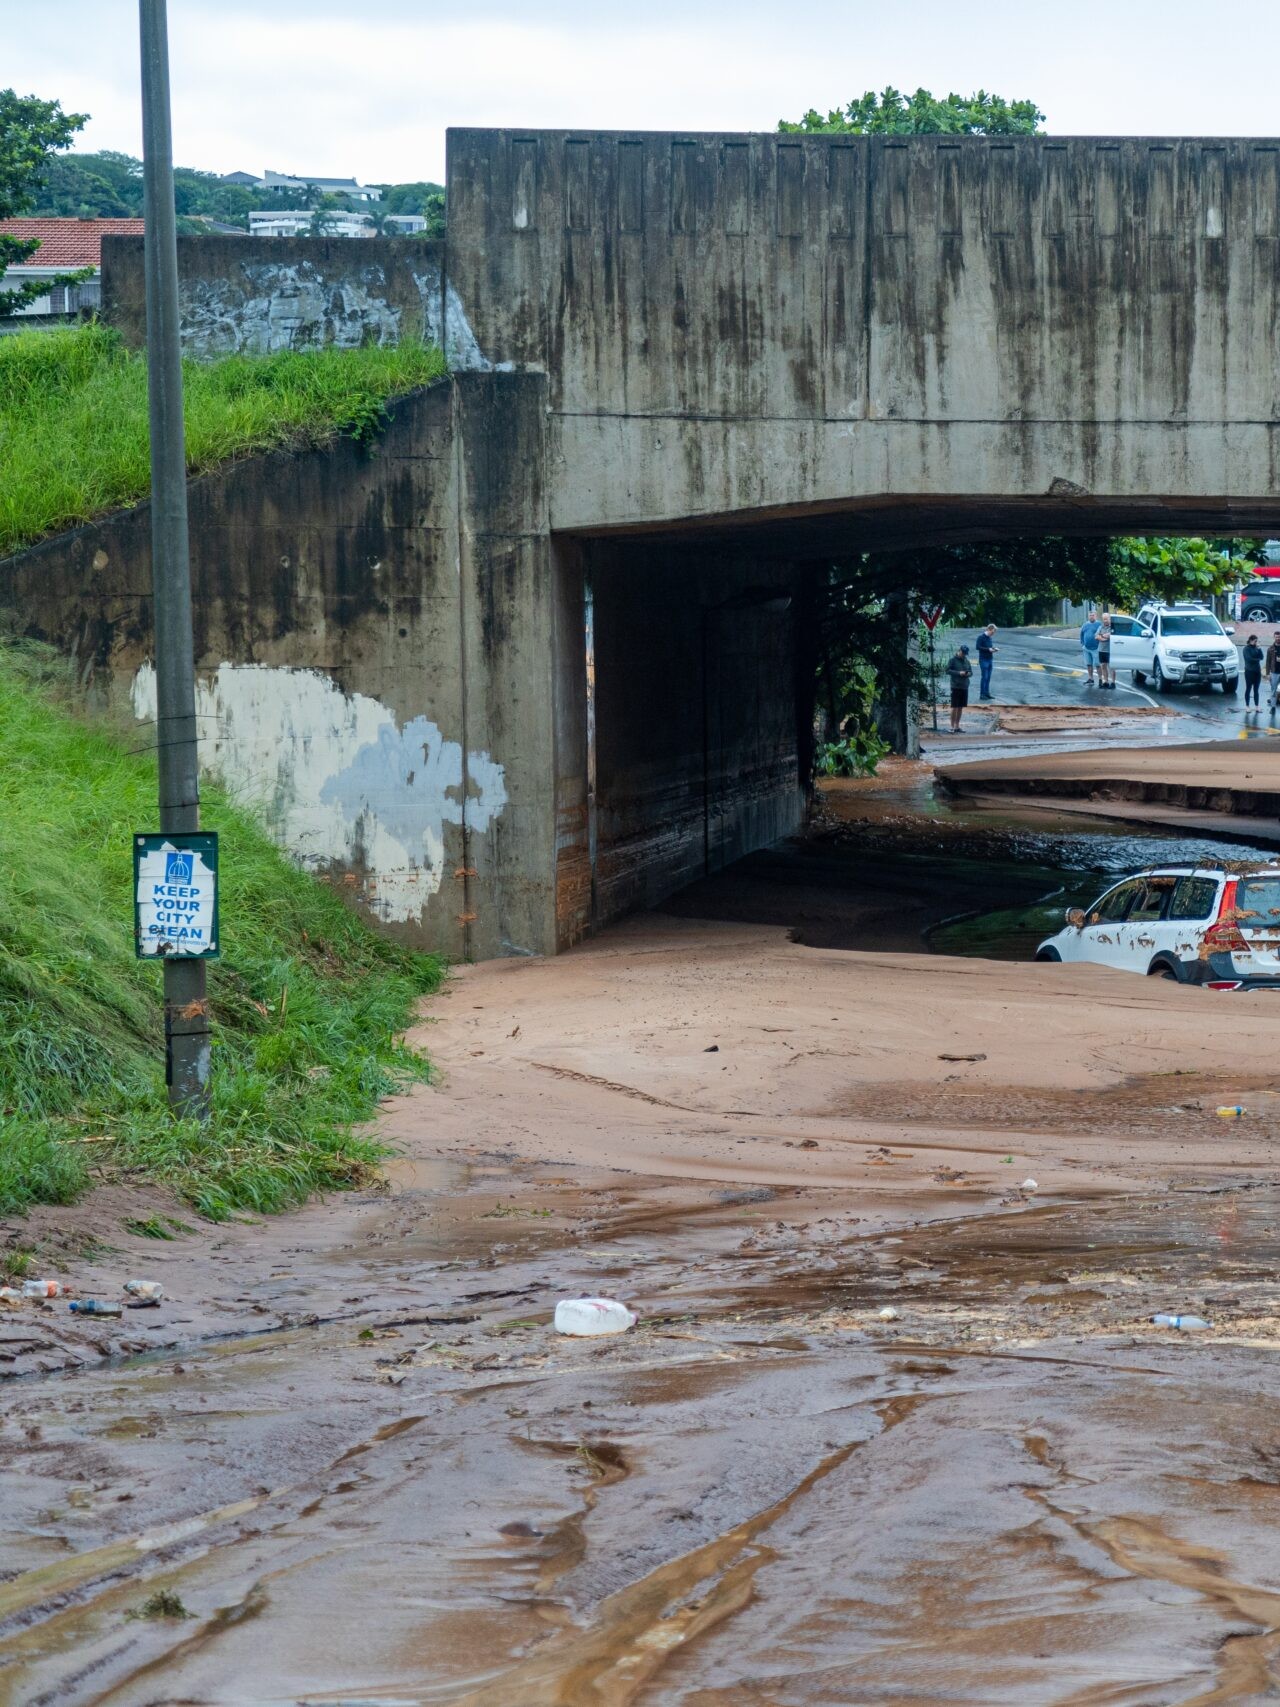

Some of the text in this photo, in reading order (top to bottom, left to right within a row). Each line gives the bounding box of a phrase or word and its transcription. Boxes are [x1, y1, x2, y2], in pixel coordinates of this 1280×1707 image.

[153, 885, 200, 898] KEEP
[152, 898, 200, 912] YOUR
[156, 911, 195, 924] CITY
[148, 924, 203, 939] CLEAN
